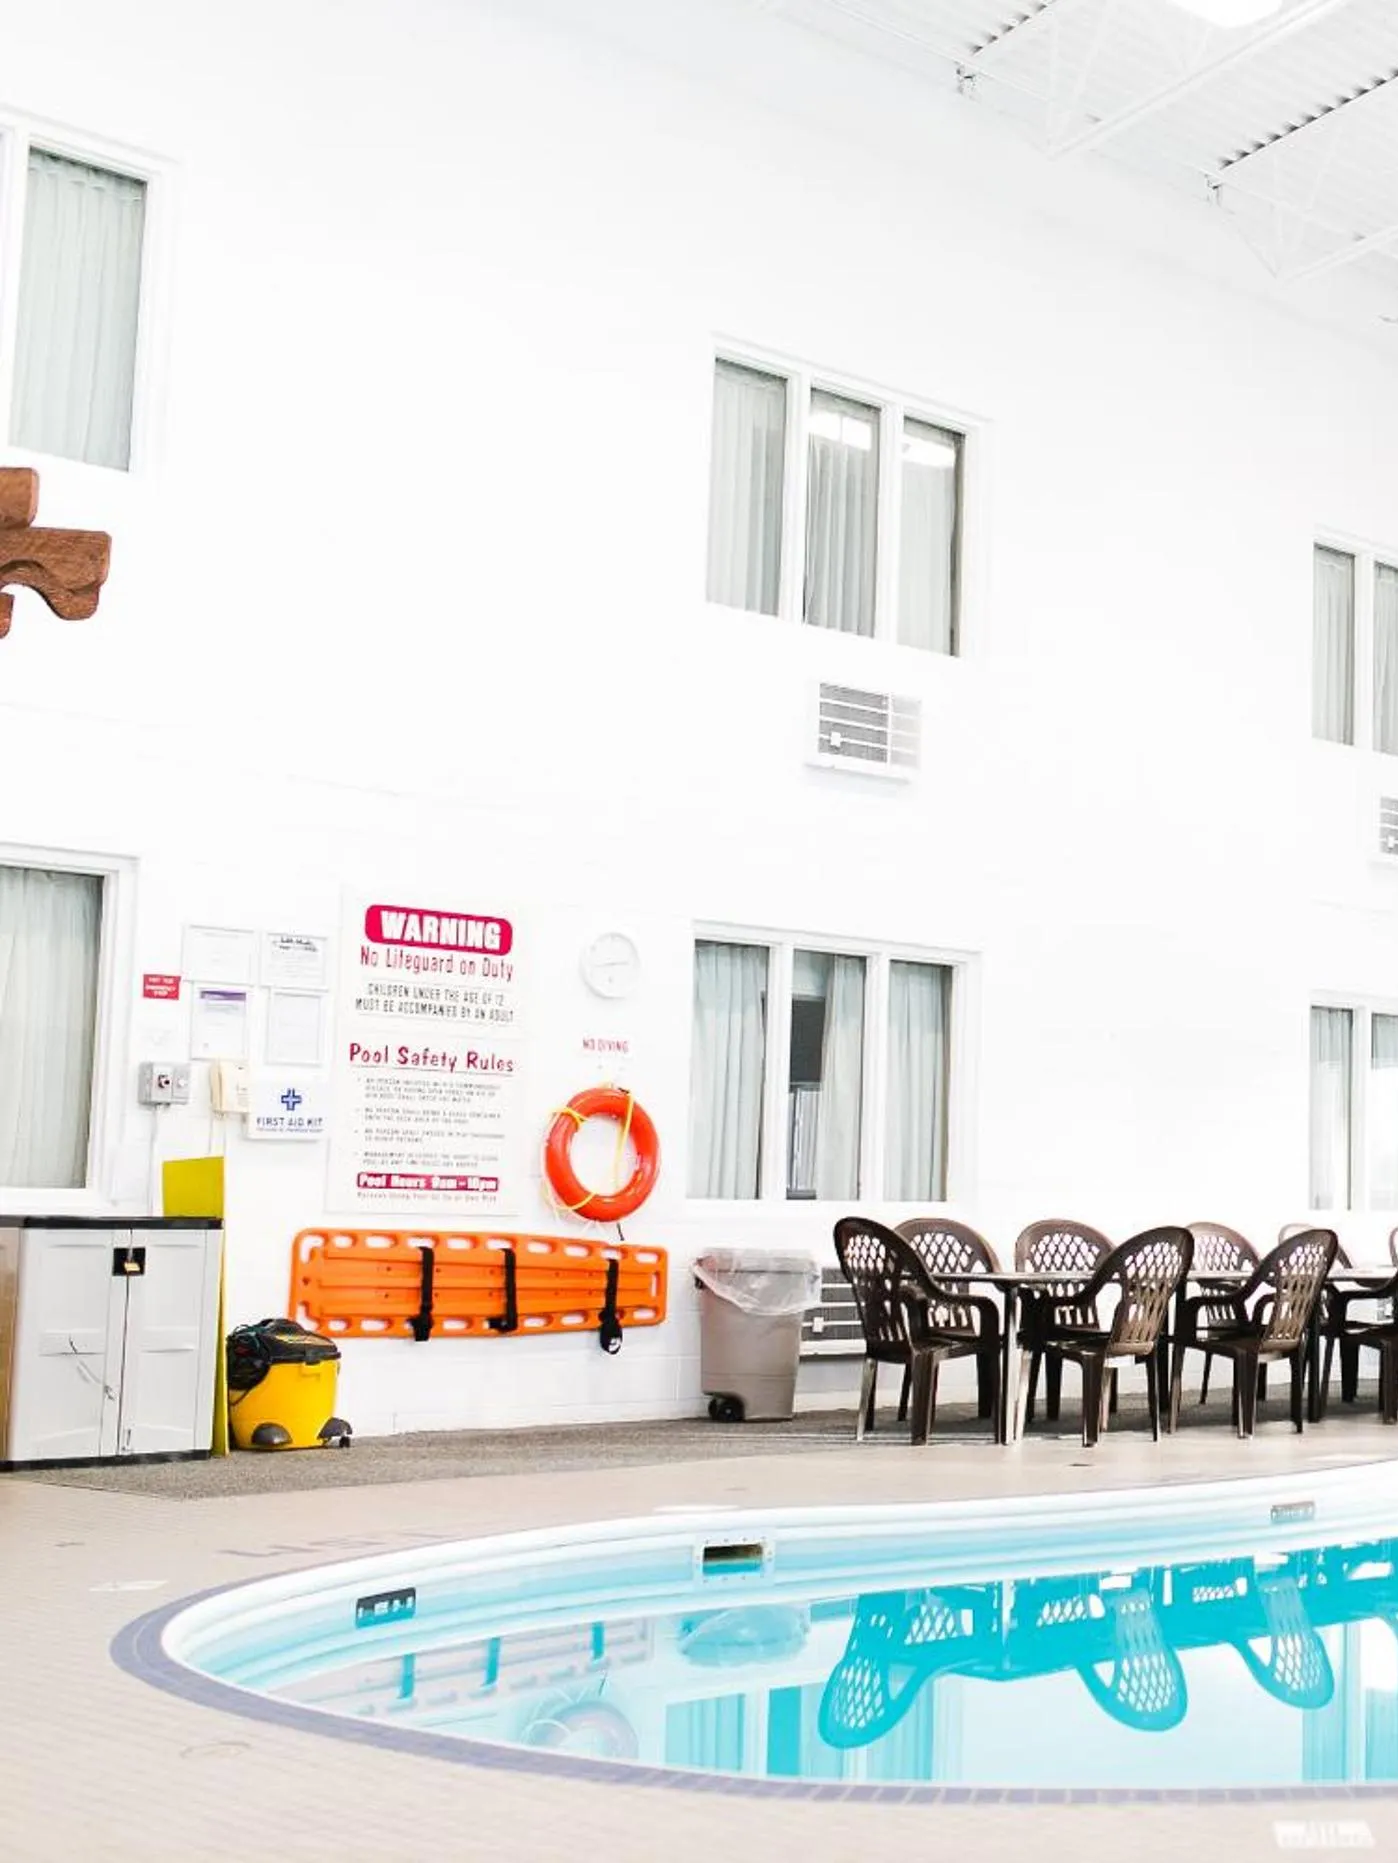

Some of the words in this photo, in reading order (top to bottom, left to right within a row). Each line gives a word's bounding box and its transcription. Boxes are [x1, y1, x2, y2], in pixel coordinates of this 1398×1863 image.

[379, 910, 502, 950] WARNING
[360, 945, 379, 967] No
[386, 948, 454, 974] Lifeguard
[459, 958, 476, 976] on
[482, 957, 514, 982] Duty
[368, 983, 409, 998] CHILDREN
[413, 986, 440, 1001] UNDER
[444, 989, 459, 1003] THE
[463, 991, 478, 1005] AGE
[482, 992, 492, 1006] OF
[355, 998, 380, 1011] MUST
[383, 1000, 394, 1013] BE
[474, 1007, 486, 1020] AN
[489, 1008, 514, 1022] ADULT
[583, 1038, 595, 1051] NO
[598, 1039, 629, 1054] DIVING
[350, 1043, 389, 1064] Pool
[397, 1046, 458, 1074] Safety
[466, 1051, 514, 1072] Rules
[256, 1117, 285, 1127] FIRST
[287, 1117, 304, 1127] AID
[307, 1117, 323, 1127] KIT
[359, 1173, 386, 1188] Pool
[390, 1174, 426, 1190] Hours
